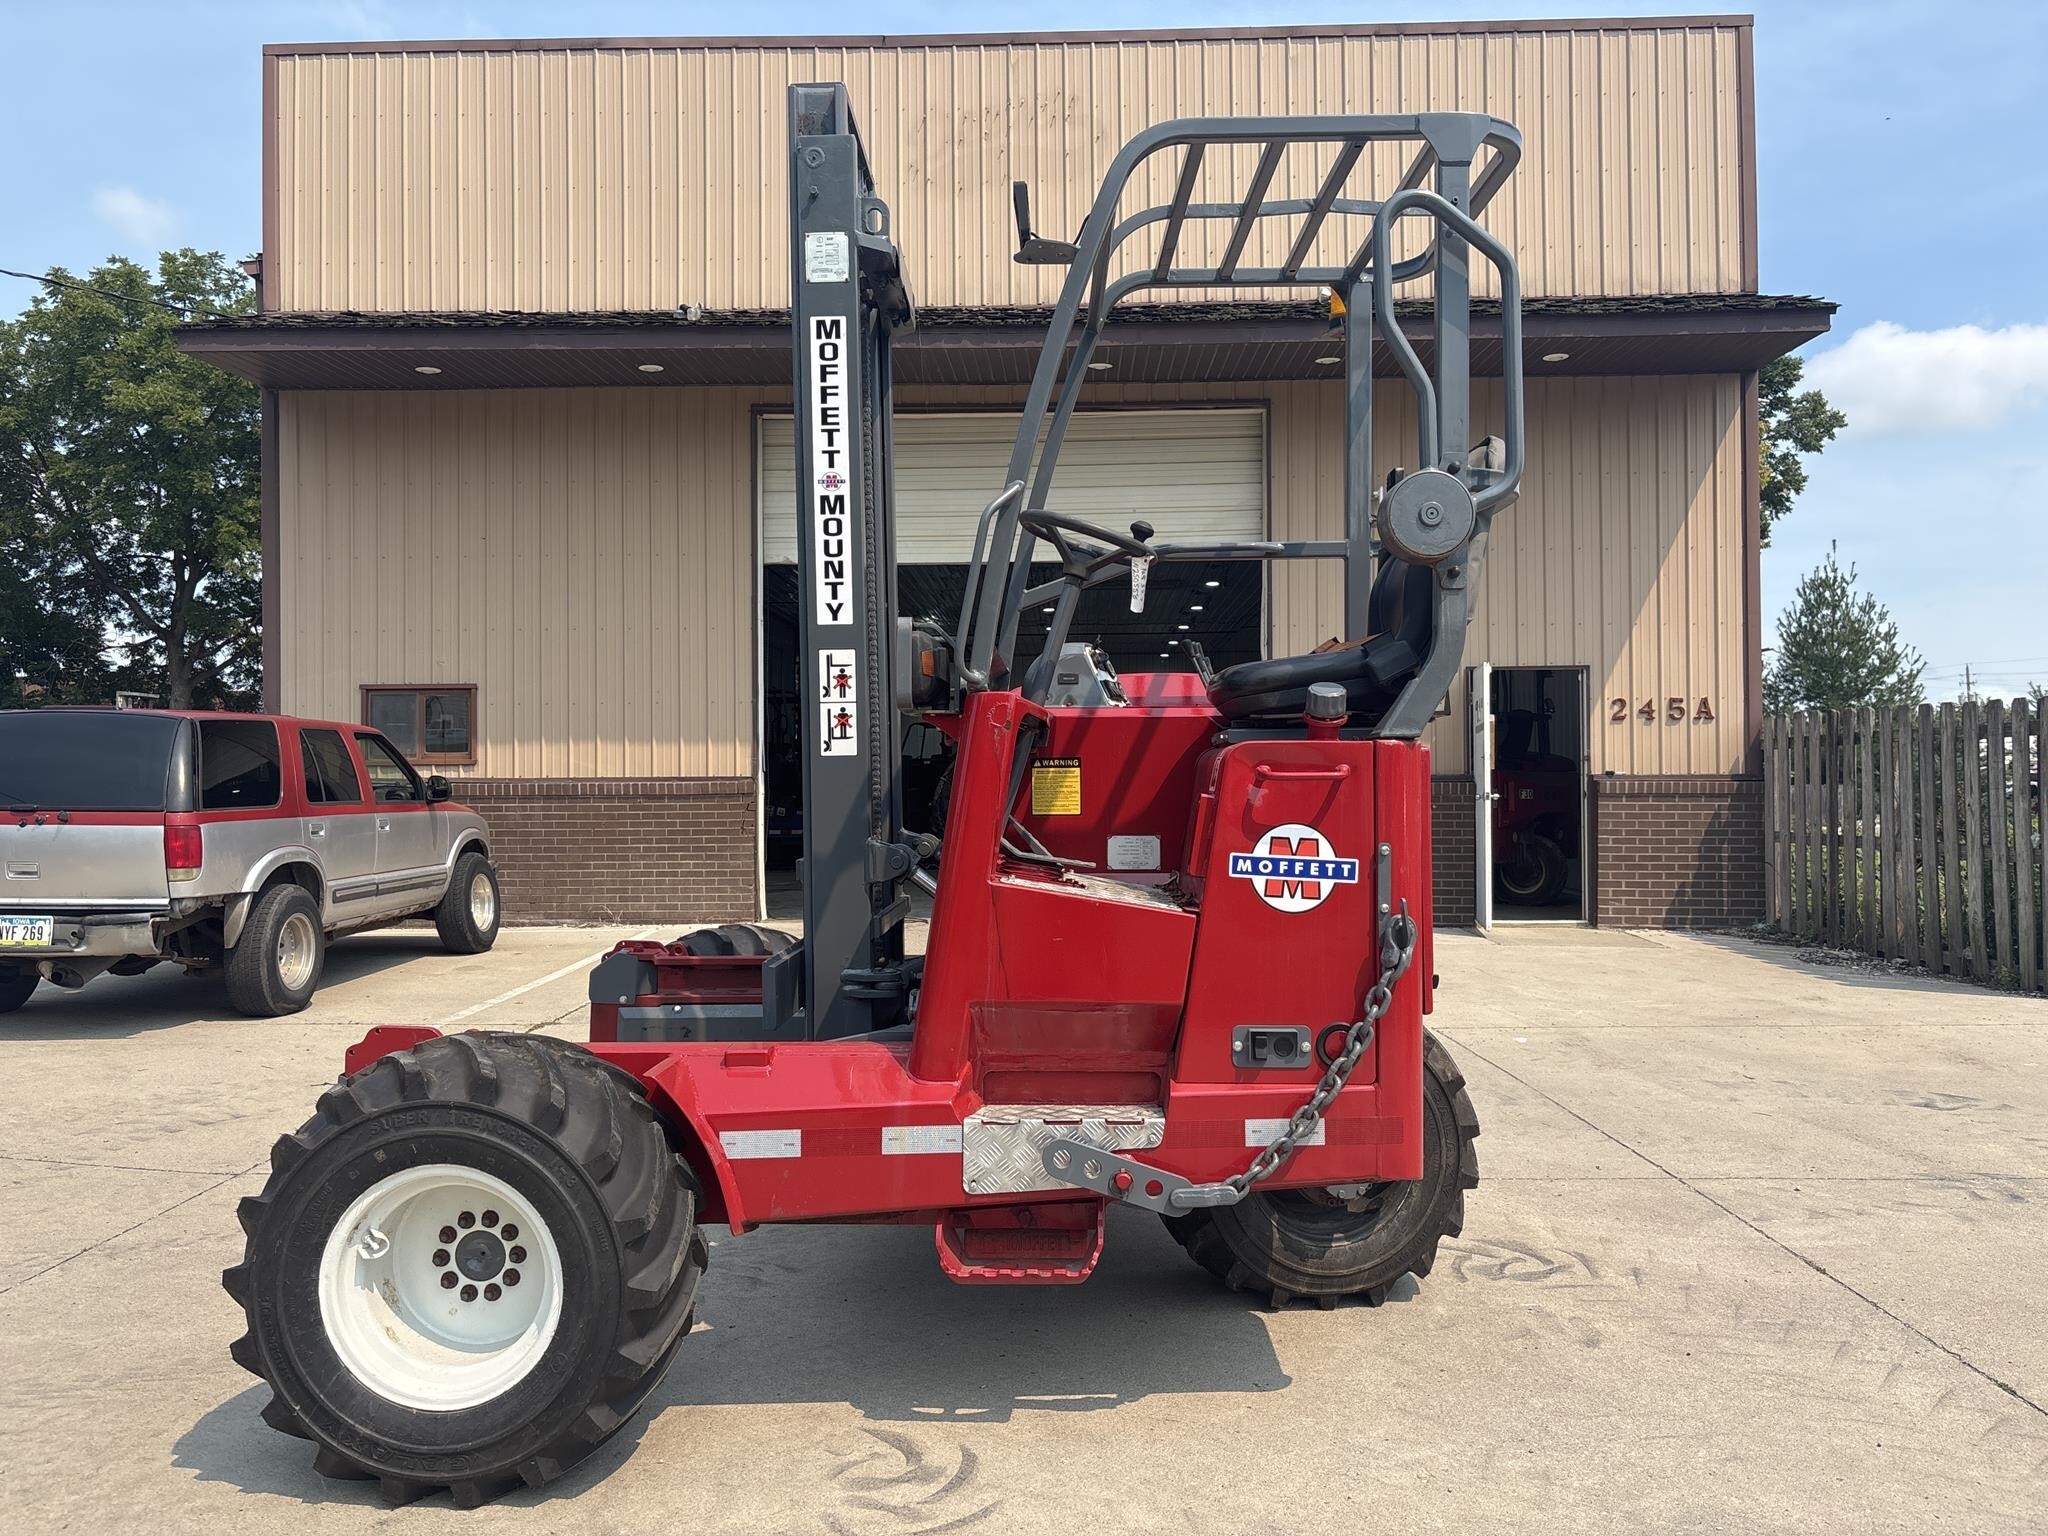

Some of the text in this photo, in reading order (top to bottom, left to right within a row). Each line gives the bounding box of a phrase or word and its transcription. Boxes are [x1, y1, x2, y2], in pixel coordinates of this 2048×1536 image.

[816, 319, 841, 469] MOFFETT
[819, 494, 845, 621] MOUNTY
[1611, 697, 1715, 721] 245A
[1236, 859, 1351, 877] MOFFETT
[22, 926, 44, 940] 269
[370, 1111, 428, 1135] SUPER
[449, 1110, 537, 1153] TRENCHER
